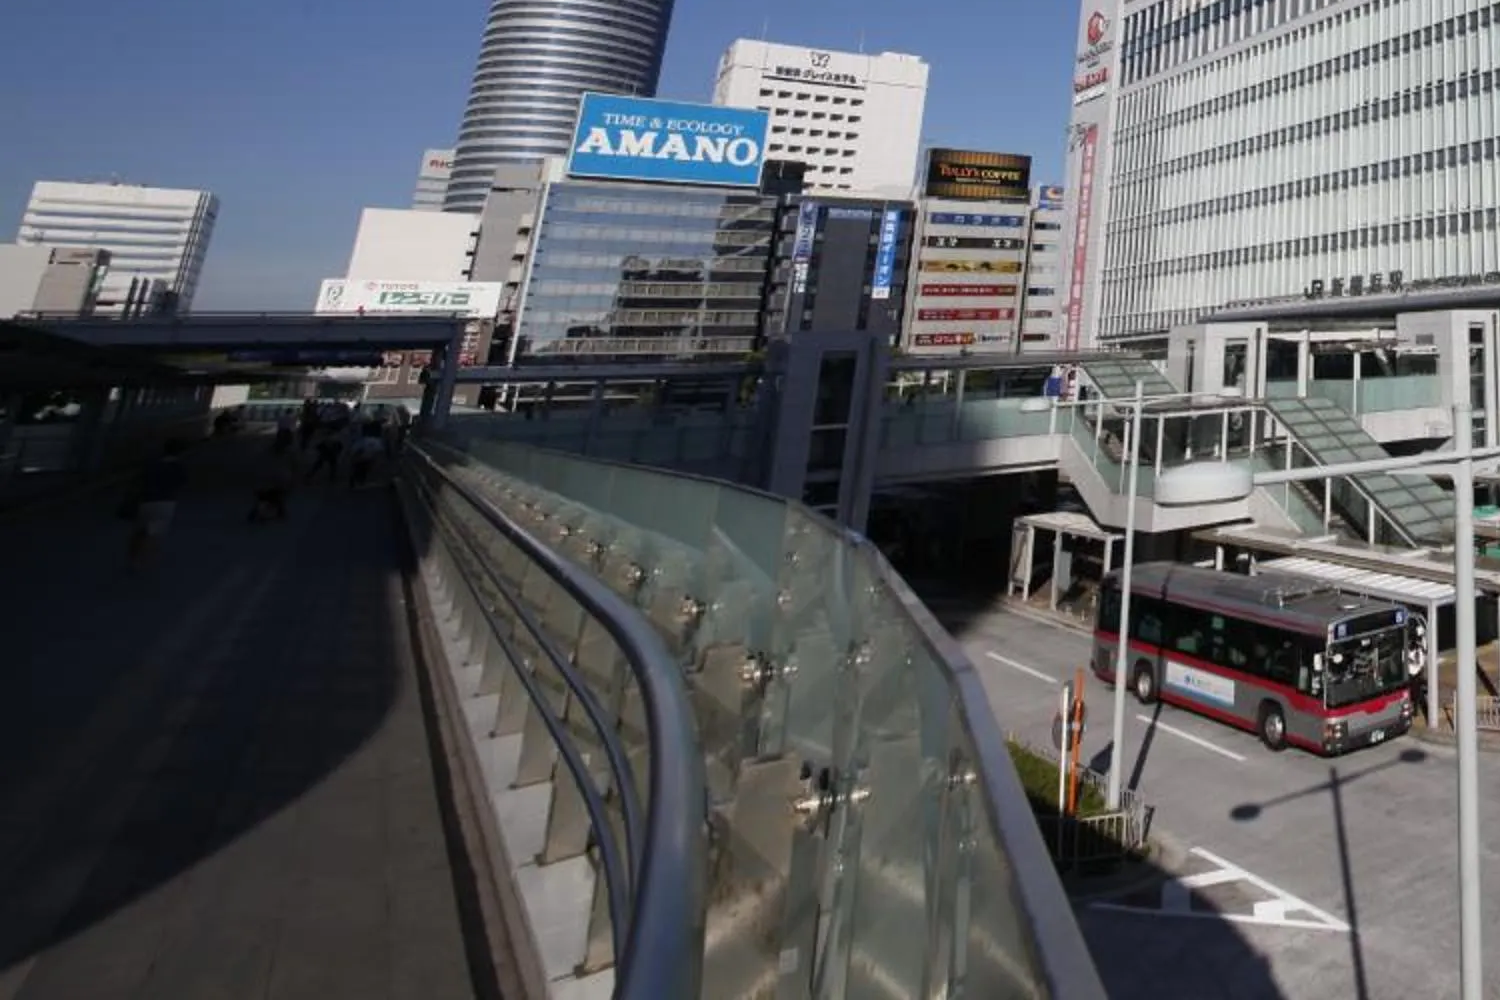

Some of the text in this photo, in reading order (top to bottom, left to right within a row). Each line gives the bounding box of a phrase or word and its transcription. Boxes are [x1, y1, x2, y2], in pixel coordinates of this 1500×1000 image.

[604, 113, 744, 135] TIME & ECOLOGY
[577, 127, 759, 166] AMANO
